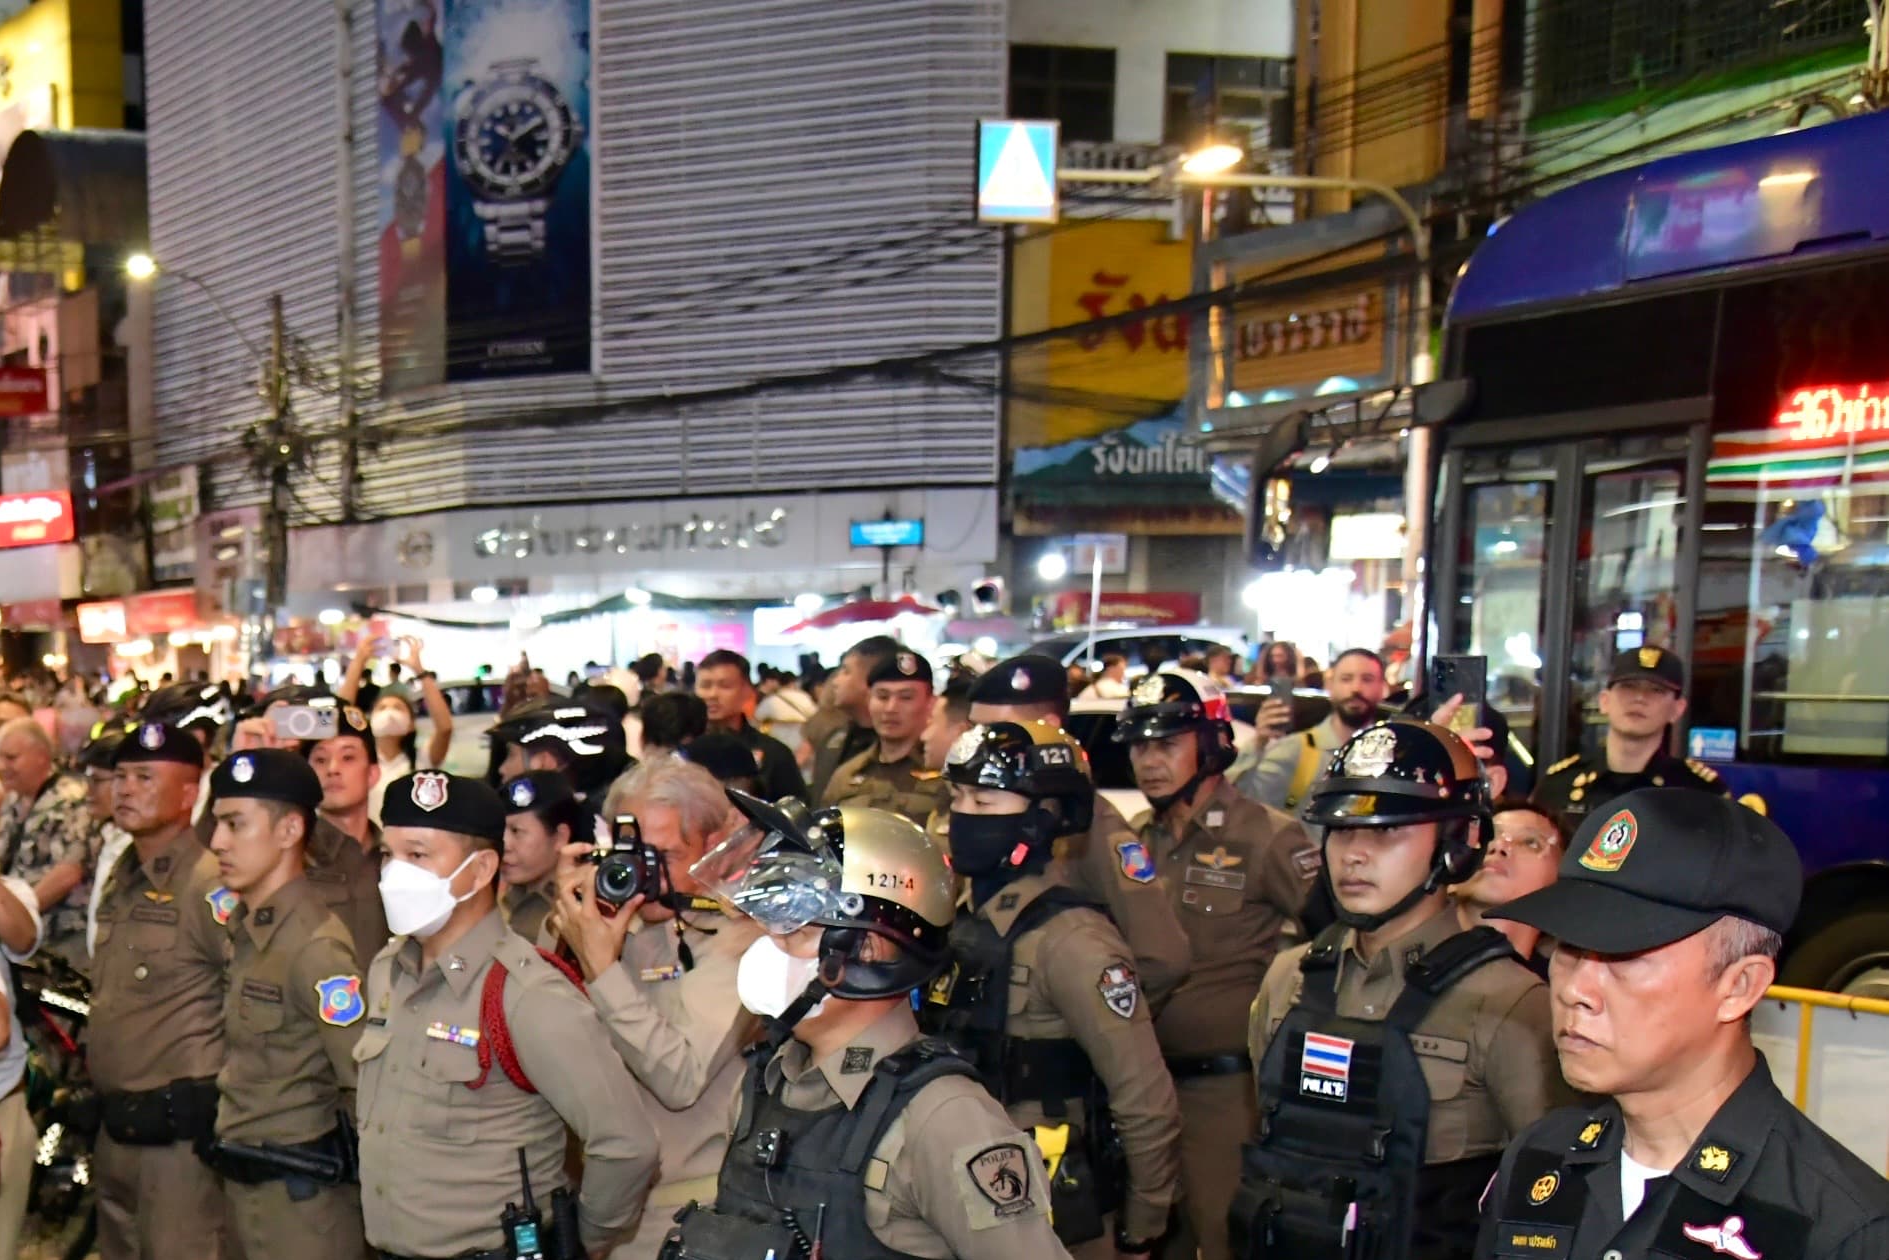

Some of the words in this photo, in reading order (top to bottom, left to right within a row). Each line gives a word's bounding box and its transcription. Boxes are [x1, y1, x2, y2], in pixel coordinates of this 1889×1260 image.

[1039, 748, 1070, 765] 121
[1302, 1077, 1345, 1097] POLICE
[980, 1150, 1016, 1167] POLICE
